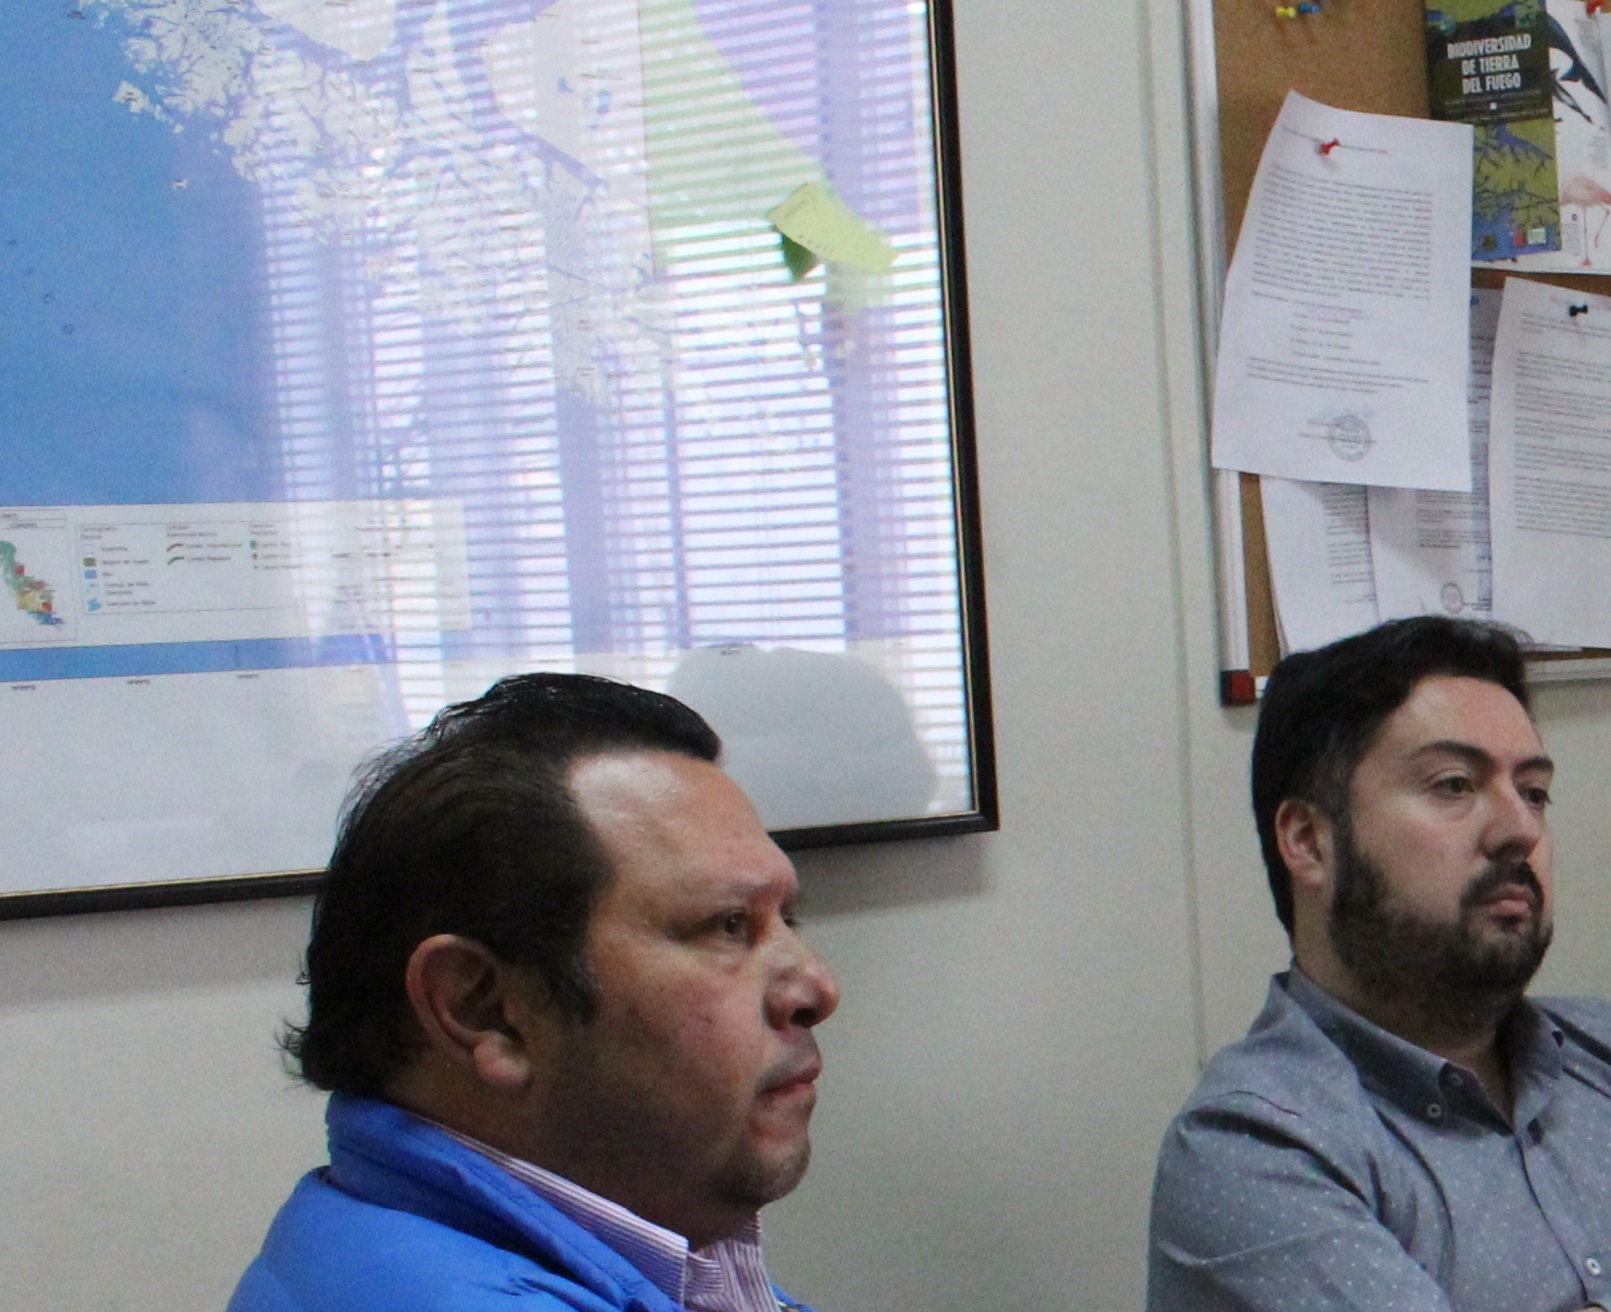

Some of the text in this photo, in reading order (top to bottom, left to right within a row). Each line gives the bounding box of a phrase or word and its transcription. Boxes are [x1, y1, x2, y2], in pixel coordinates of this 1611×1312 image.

[1447, 33, 1532, 59] BIODIVERSIDAD
[1461, 54, 1520, 76] DE TIERRA
[1462, 72, 1522, 95] DEL FUEGO
